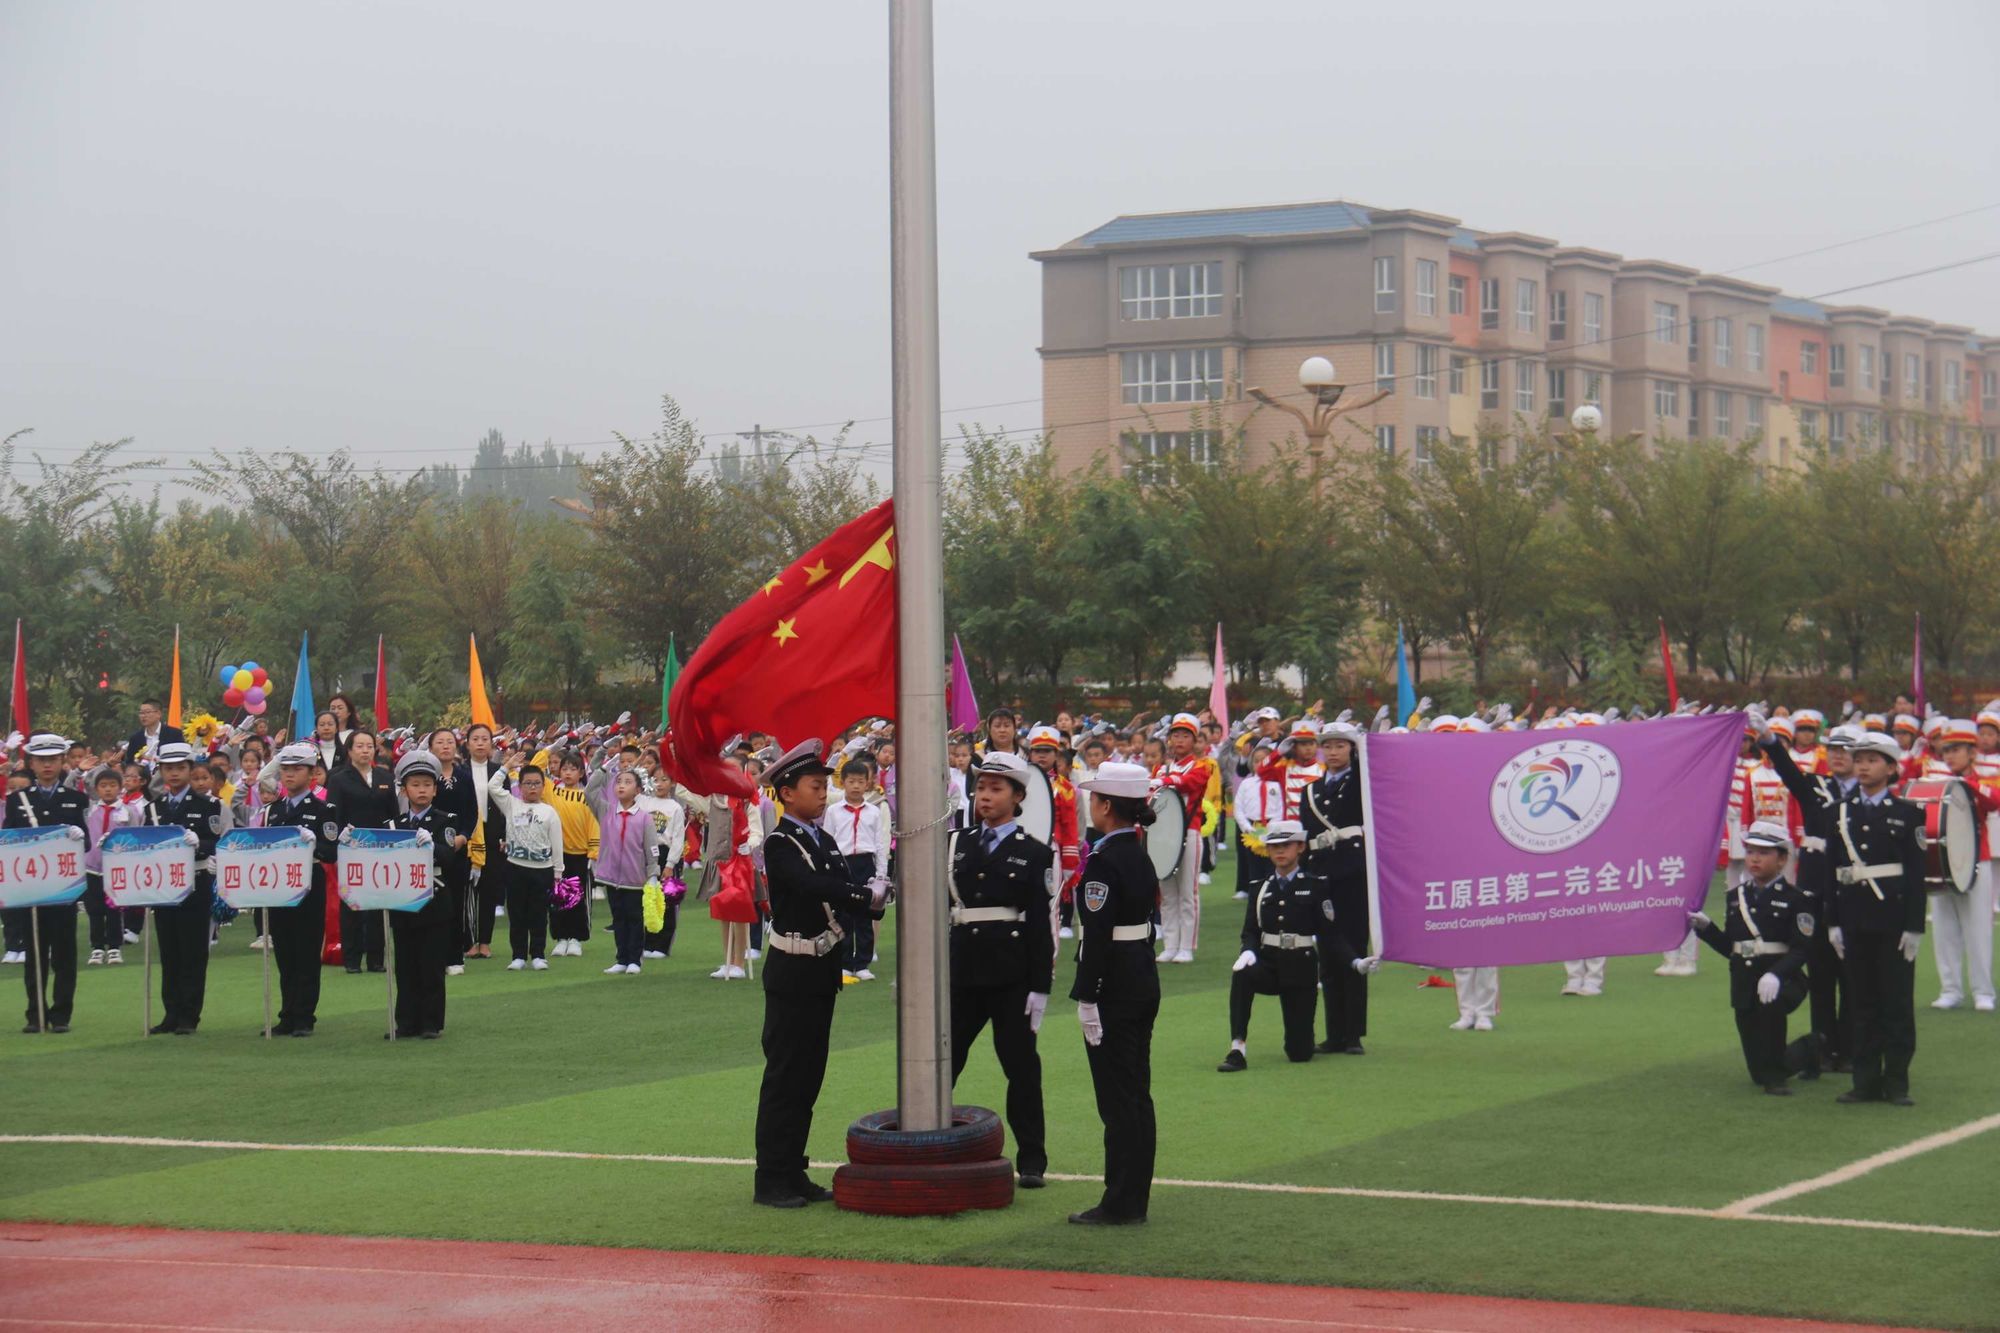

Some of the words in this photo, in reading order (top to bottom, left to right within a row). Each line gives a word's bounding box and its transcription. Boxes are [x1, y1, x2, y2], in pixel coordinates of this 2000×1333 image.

[0, 852, 78, 883] （4）班
[1424, 855, 1685, 911] 五原县第二完全小学
[1424, 919, 1459, 931] Second
[1460, 915, 1505, 928] Complete
[1507, 910, 1547, 924] Primary
[1549, 904, 1585, 919] School
[1587, 904, 1597, 914] in
[1598, 899, 1644, 912] Wuyuan
[1646, 896, 1685, 908] County
